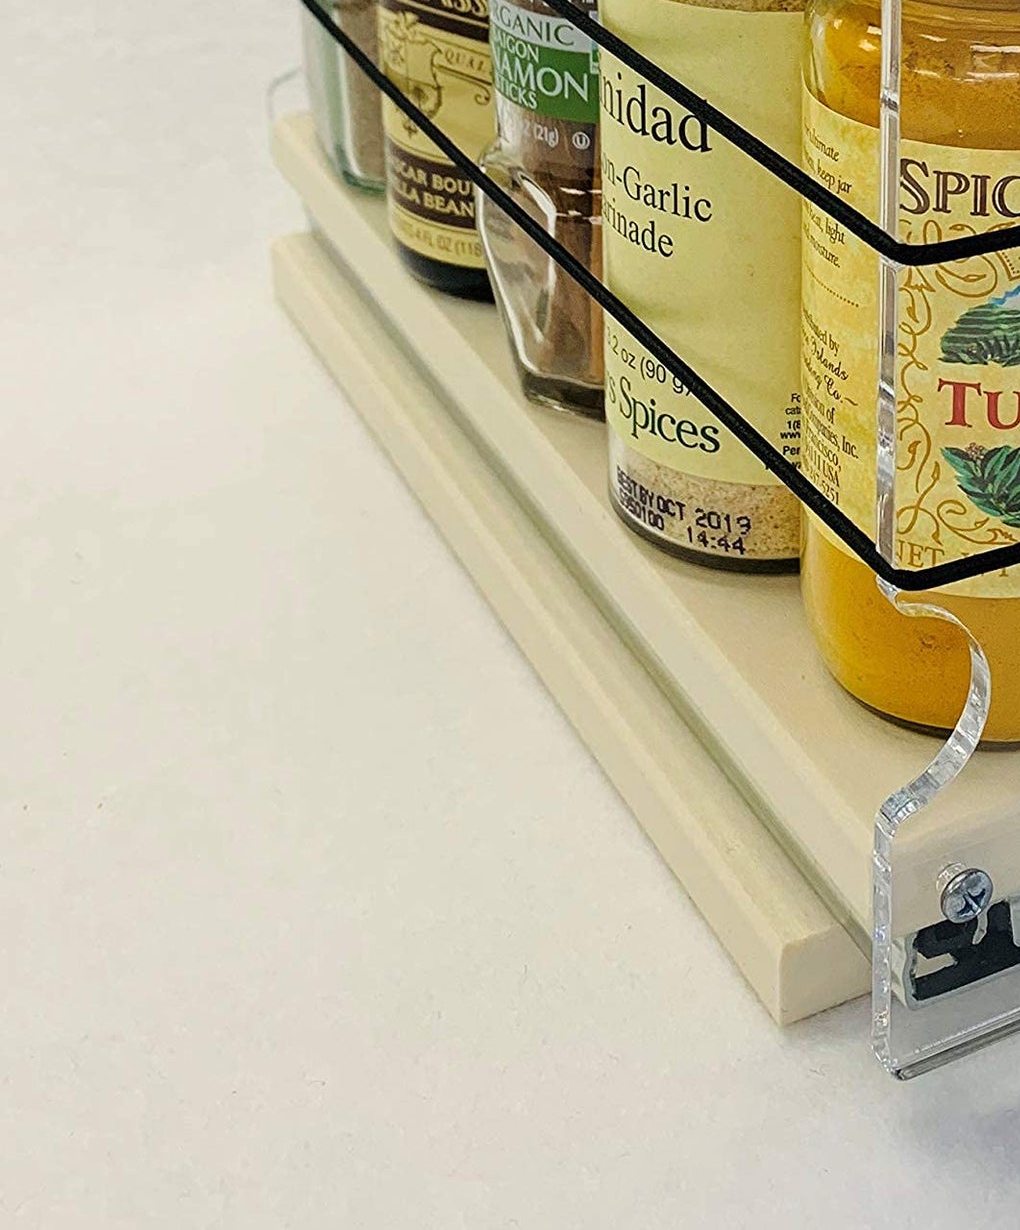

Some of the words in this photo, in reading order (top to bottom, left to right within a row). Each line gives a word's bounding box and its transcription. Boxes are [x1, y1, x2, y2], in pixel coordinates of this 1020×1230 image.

[432, 173, 476, 196] BOU
[837, 175, 852, 194] jar
[828, 333, 840, 357] by
[621, 348, 637, 370] oz
[640, 356, 667, 384] (90
[619, 376, 721, 454] Spices
[842, 435, 859, 459] Inc.
[639, 484, 655, 506] BY
[657, 495, 686, 520] OCT
[687, 525, 746, 555] 14:44
